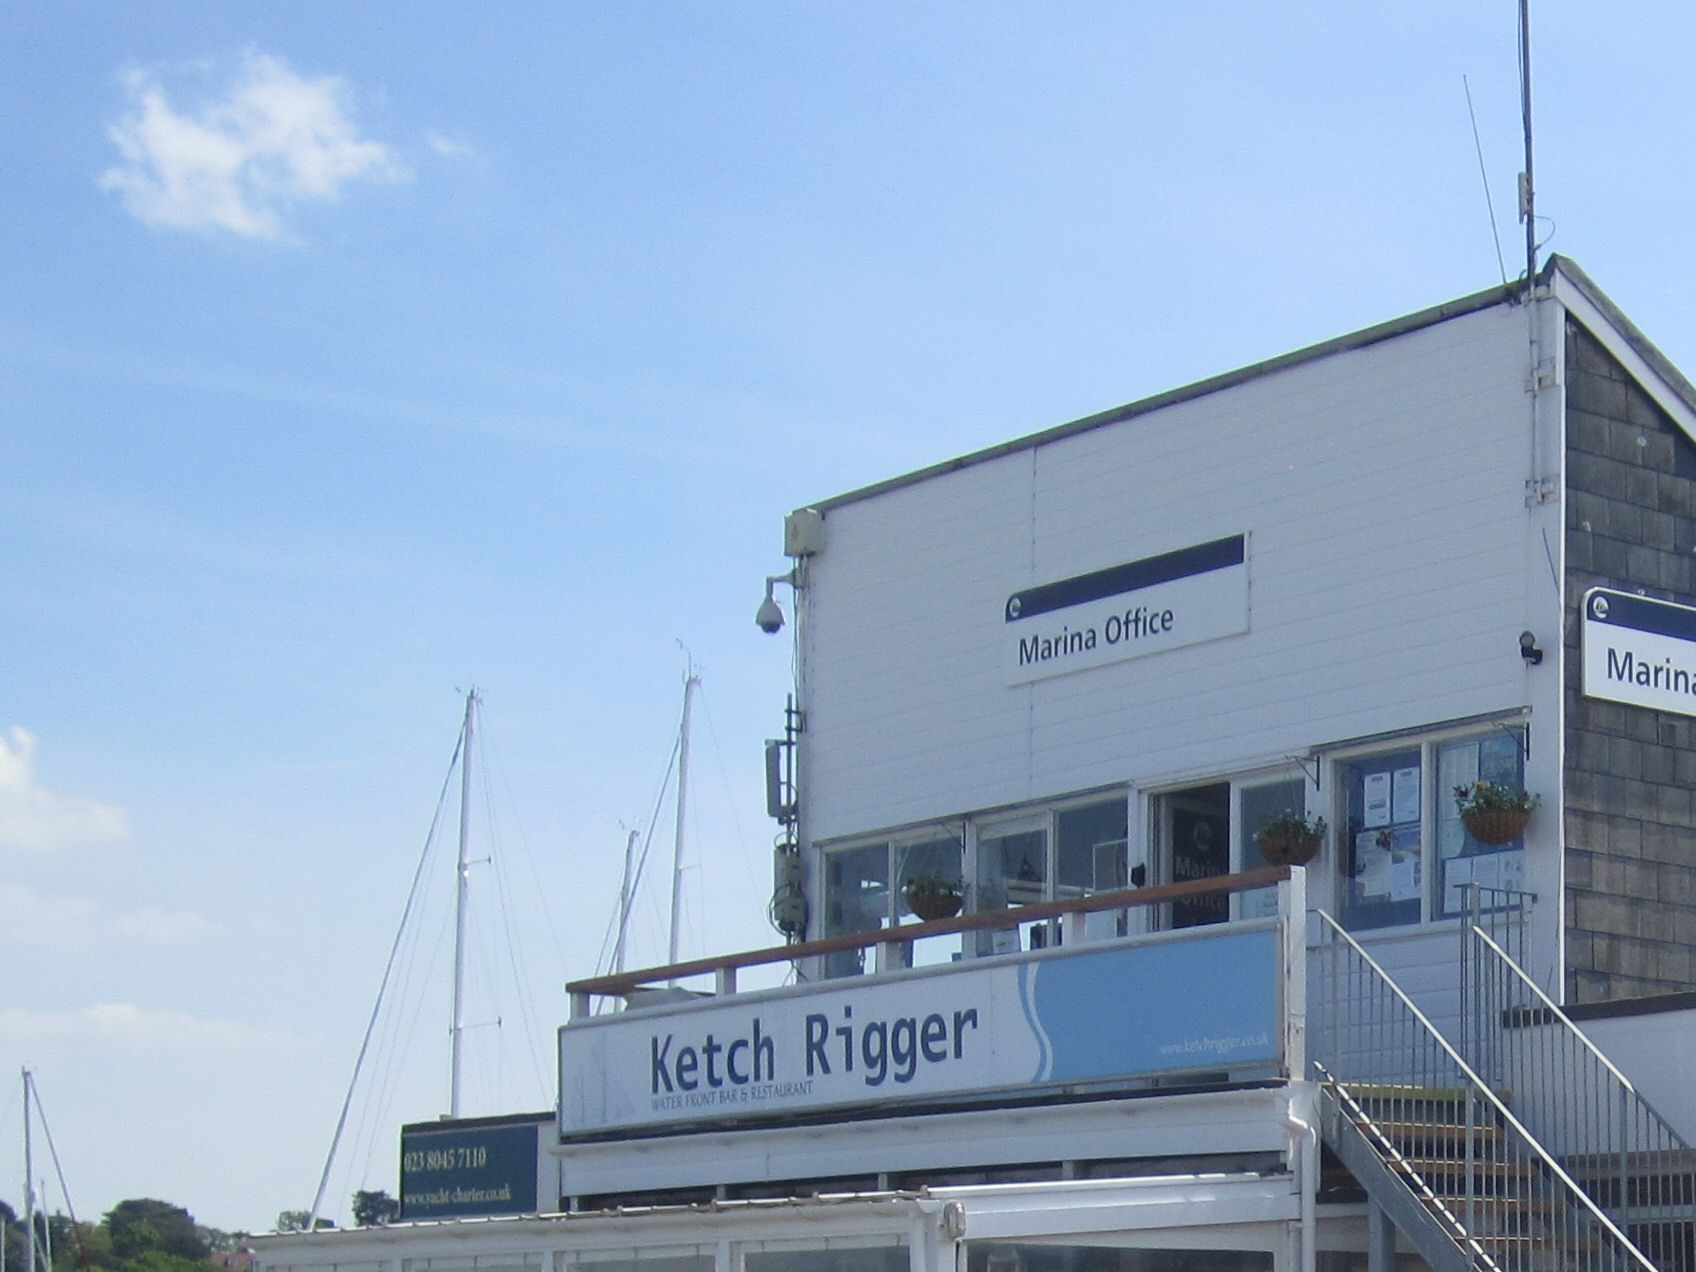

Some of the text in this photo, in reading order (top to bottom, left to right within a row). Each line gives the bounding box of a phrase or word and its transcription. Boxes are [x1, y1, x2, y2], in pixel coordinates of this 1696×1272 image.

[1018, 607, 1174, 665] Marina Office
[651, 1006, 977, 1094] Ketch Rigger
[652, 1095, 682, 1111] WATER
[719, 1089, 737, 1103] BAR
[751, 1081, 813, 1100] RESTAURANT
[403, 1146, 487, 1171] 023 8045 7110
